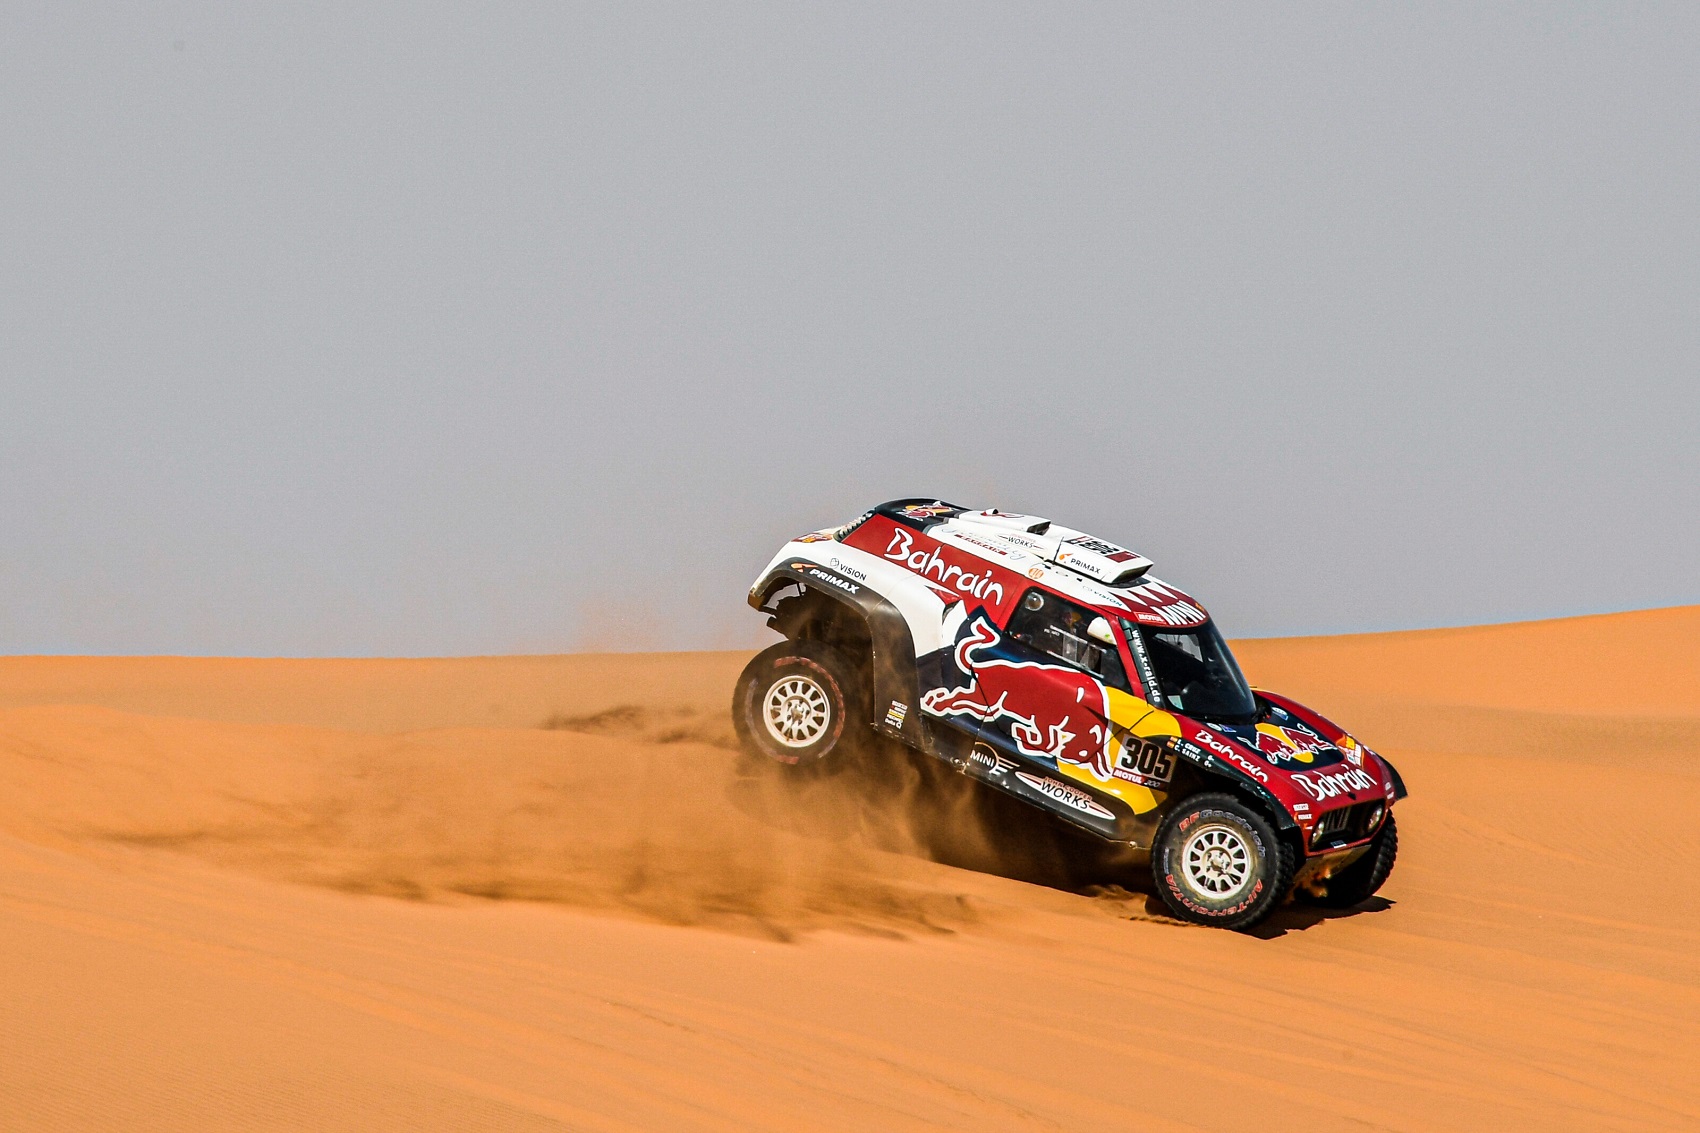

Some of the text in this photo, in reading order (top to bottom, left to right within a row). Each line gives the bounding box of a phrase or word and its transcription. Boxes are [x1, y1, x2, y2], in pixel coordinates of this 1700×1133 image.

[1008, 536, 1034, 549] WORKS
[840, 563, 867, 581] VISION
[884, 527, 1004, 606] Bahrain
[1070, 558, 1101, 574] PRIMAX
[808, 568, 860, 595] PRIMAX
[1150, 600, 1206, 626] MINI
[1132, 629, 1161, 703] www.x-raid.de
[969, 750, 995, 767] MINI
[1121, 737, 1174, 779] 305
[1181, 748, 1201, 762] SAINZ
[1194, 729, 1269, 783] Bahrain
[1113, 769, 1143, 784] MOTUL
[1290, 763, 1378, 802] Bahrain
[1041, 781, 1090, 810] WORKS
